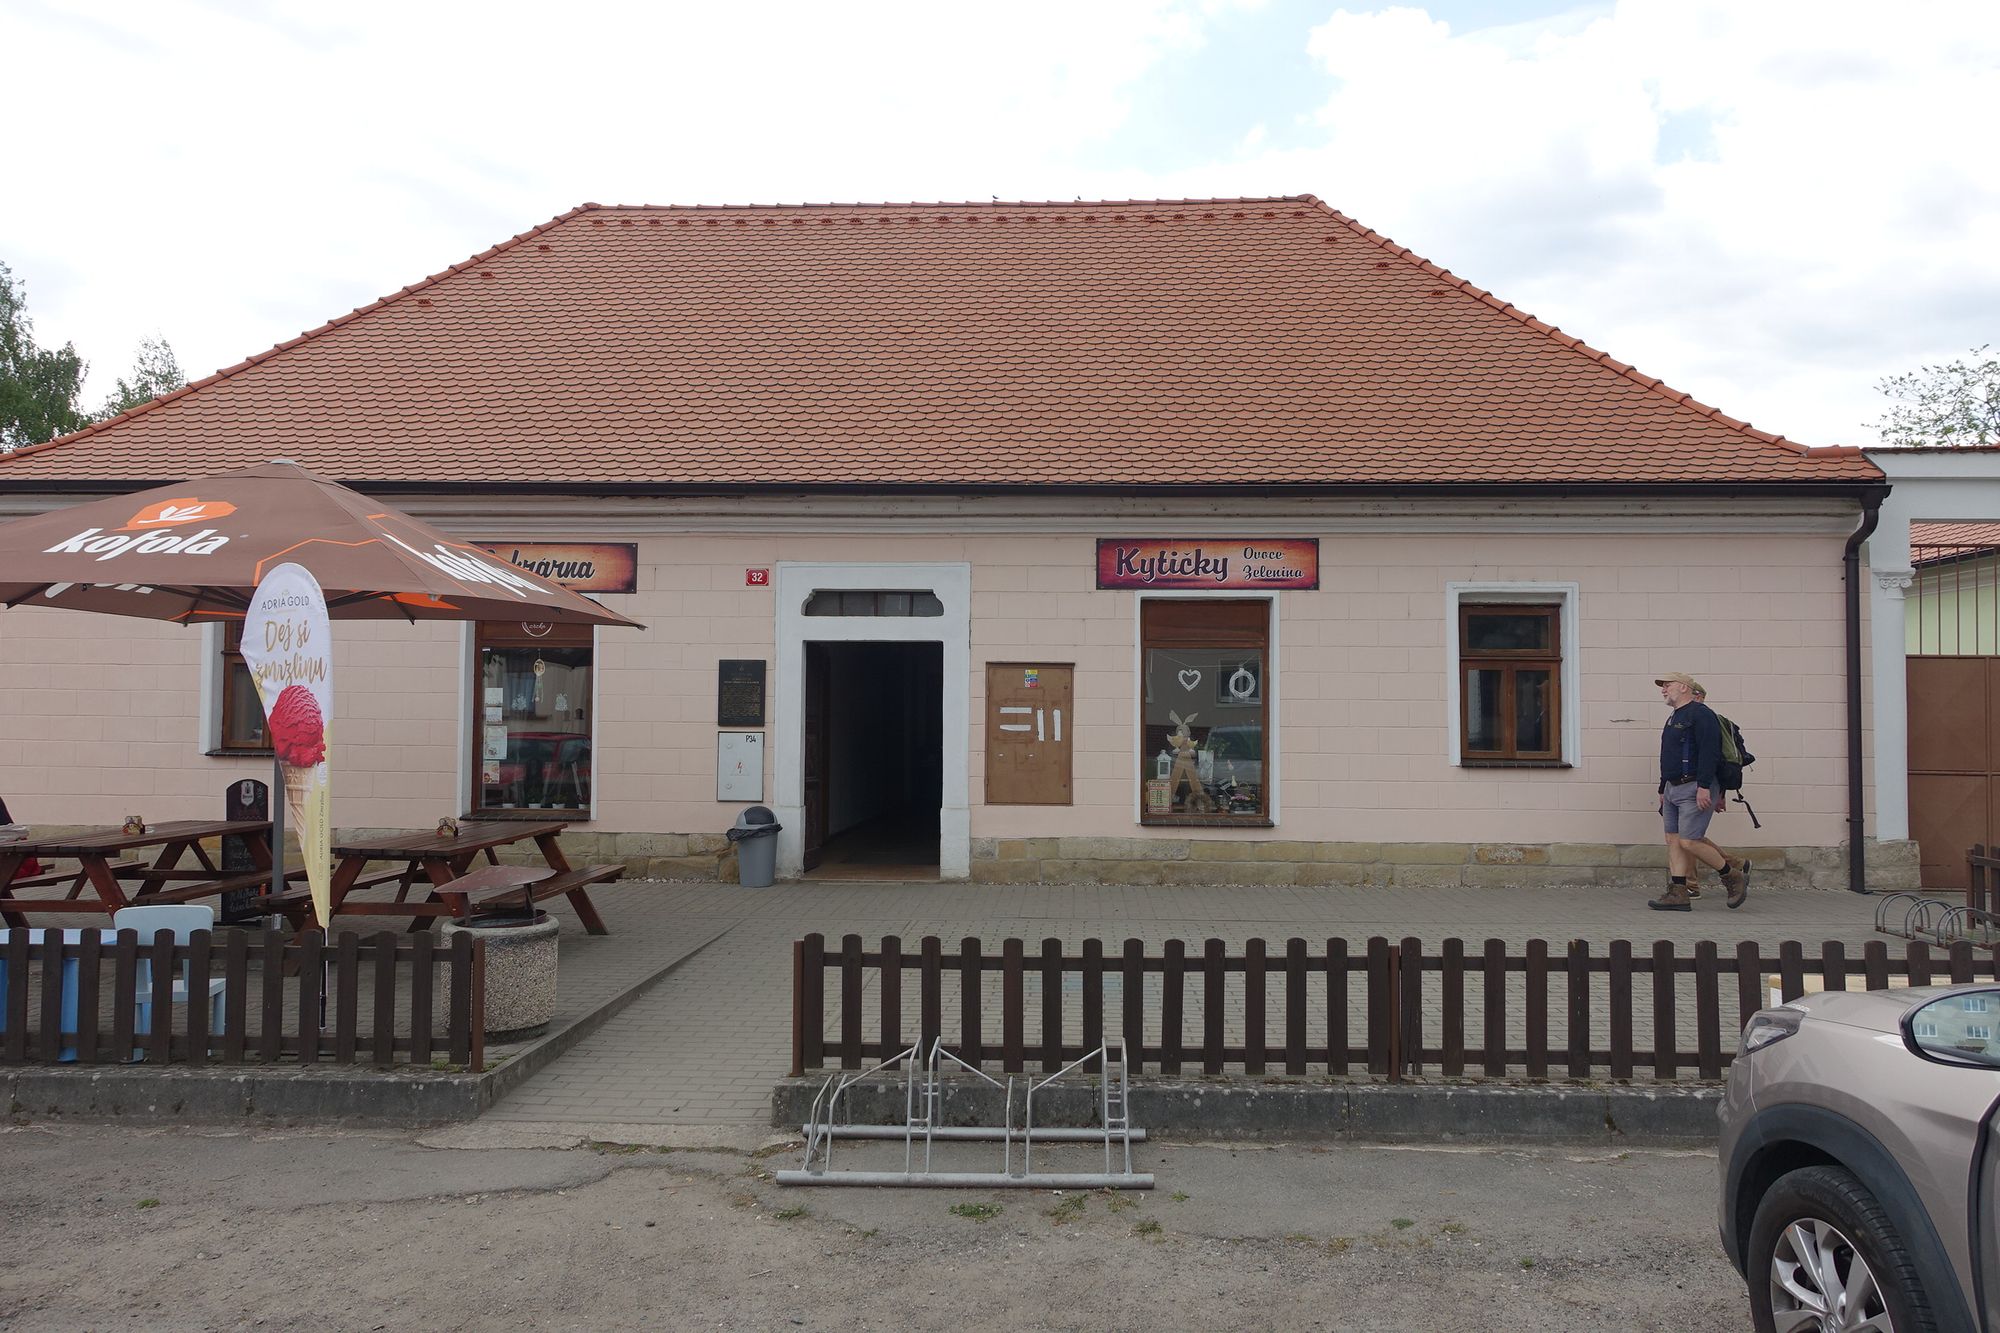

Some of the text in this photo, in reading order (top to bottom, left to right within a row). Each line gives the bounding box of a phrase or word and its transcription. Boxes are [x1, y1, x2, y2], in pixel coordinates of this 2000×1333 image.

[1243, 547, 1283, 560] Ovoce
[1115, 547, 1229, 583] Kytičky
[1242, 564, 1304, 580] Zelenina
[751, 572, 763, 582] 32
[265, 618, 311, 652] Dej si
[745, 734, 757, 743] P34
